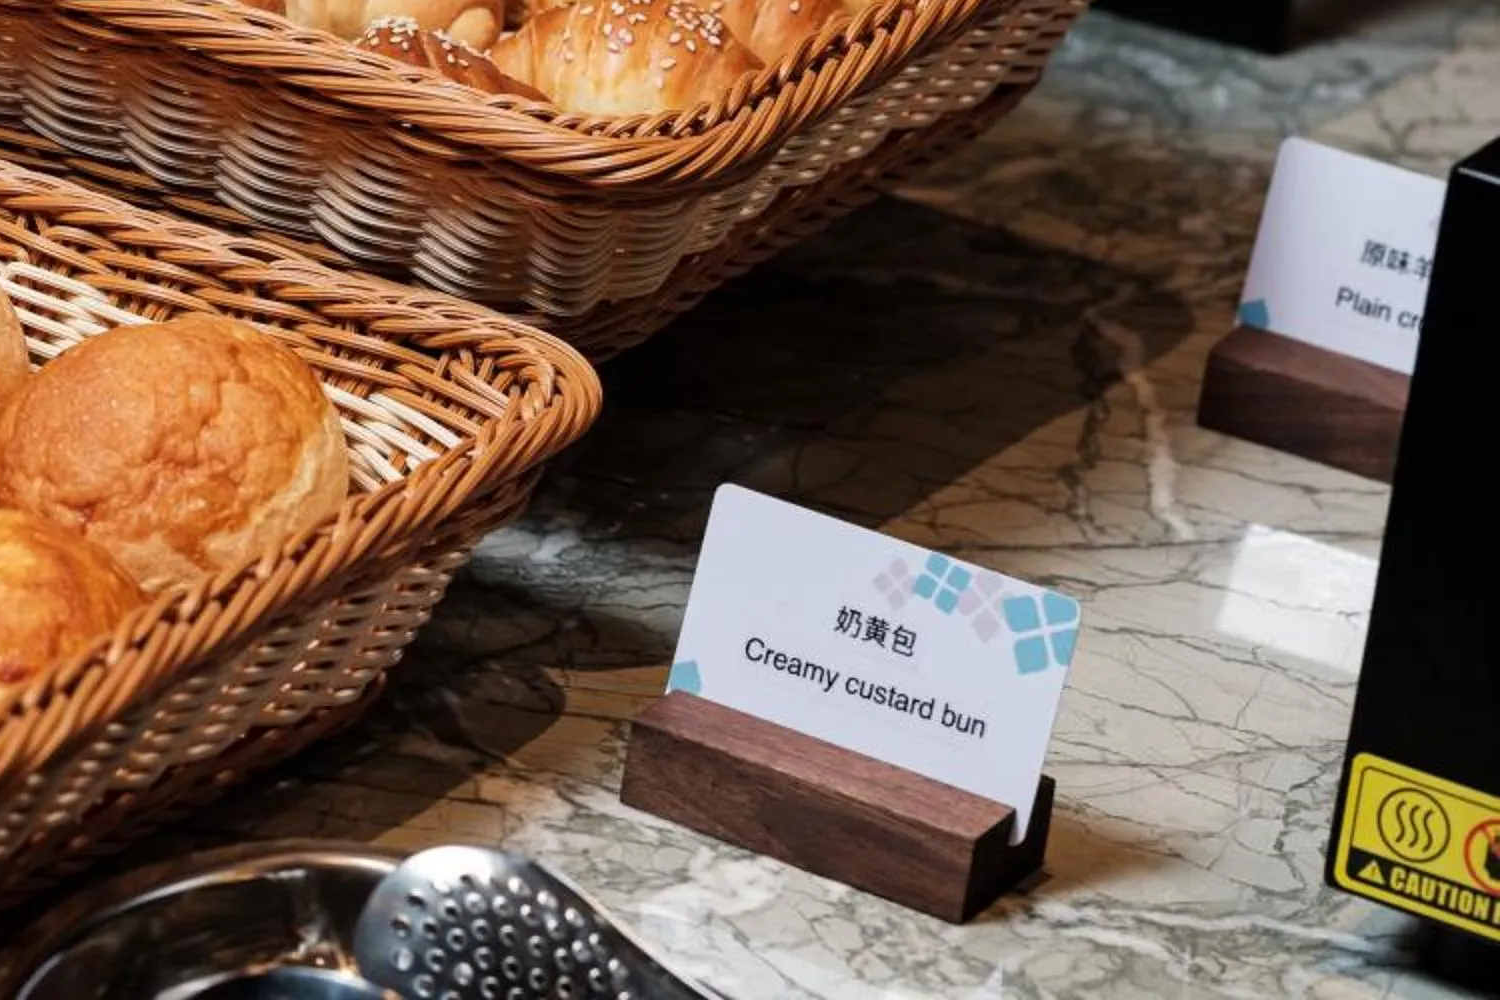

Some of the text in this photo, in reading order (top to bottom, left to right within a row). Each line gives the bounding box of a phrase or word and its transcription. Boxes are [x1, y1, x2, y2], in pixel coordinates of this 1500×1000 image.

[1335, 286, 1423, 330] Plain cr
[833, 605, 916, 657] 奶黄包
[745, 637, 986, 739] Creamy custard bun
[1389, 866, 1490, 920] CAUTION
